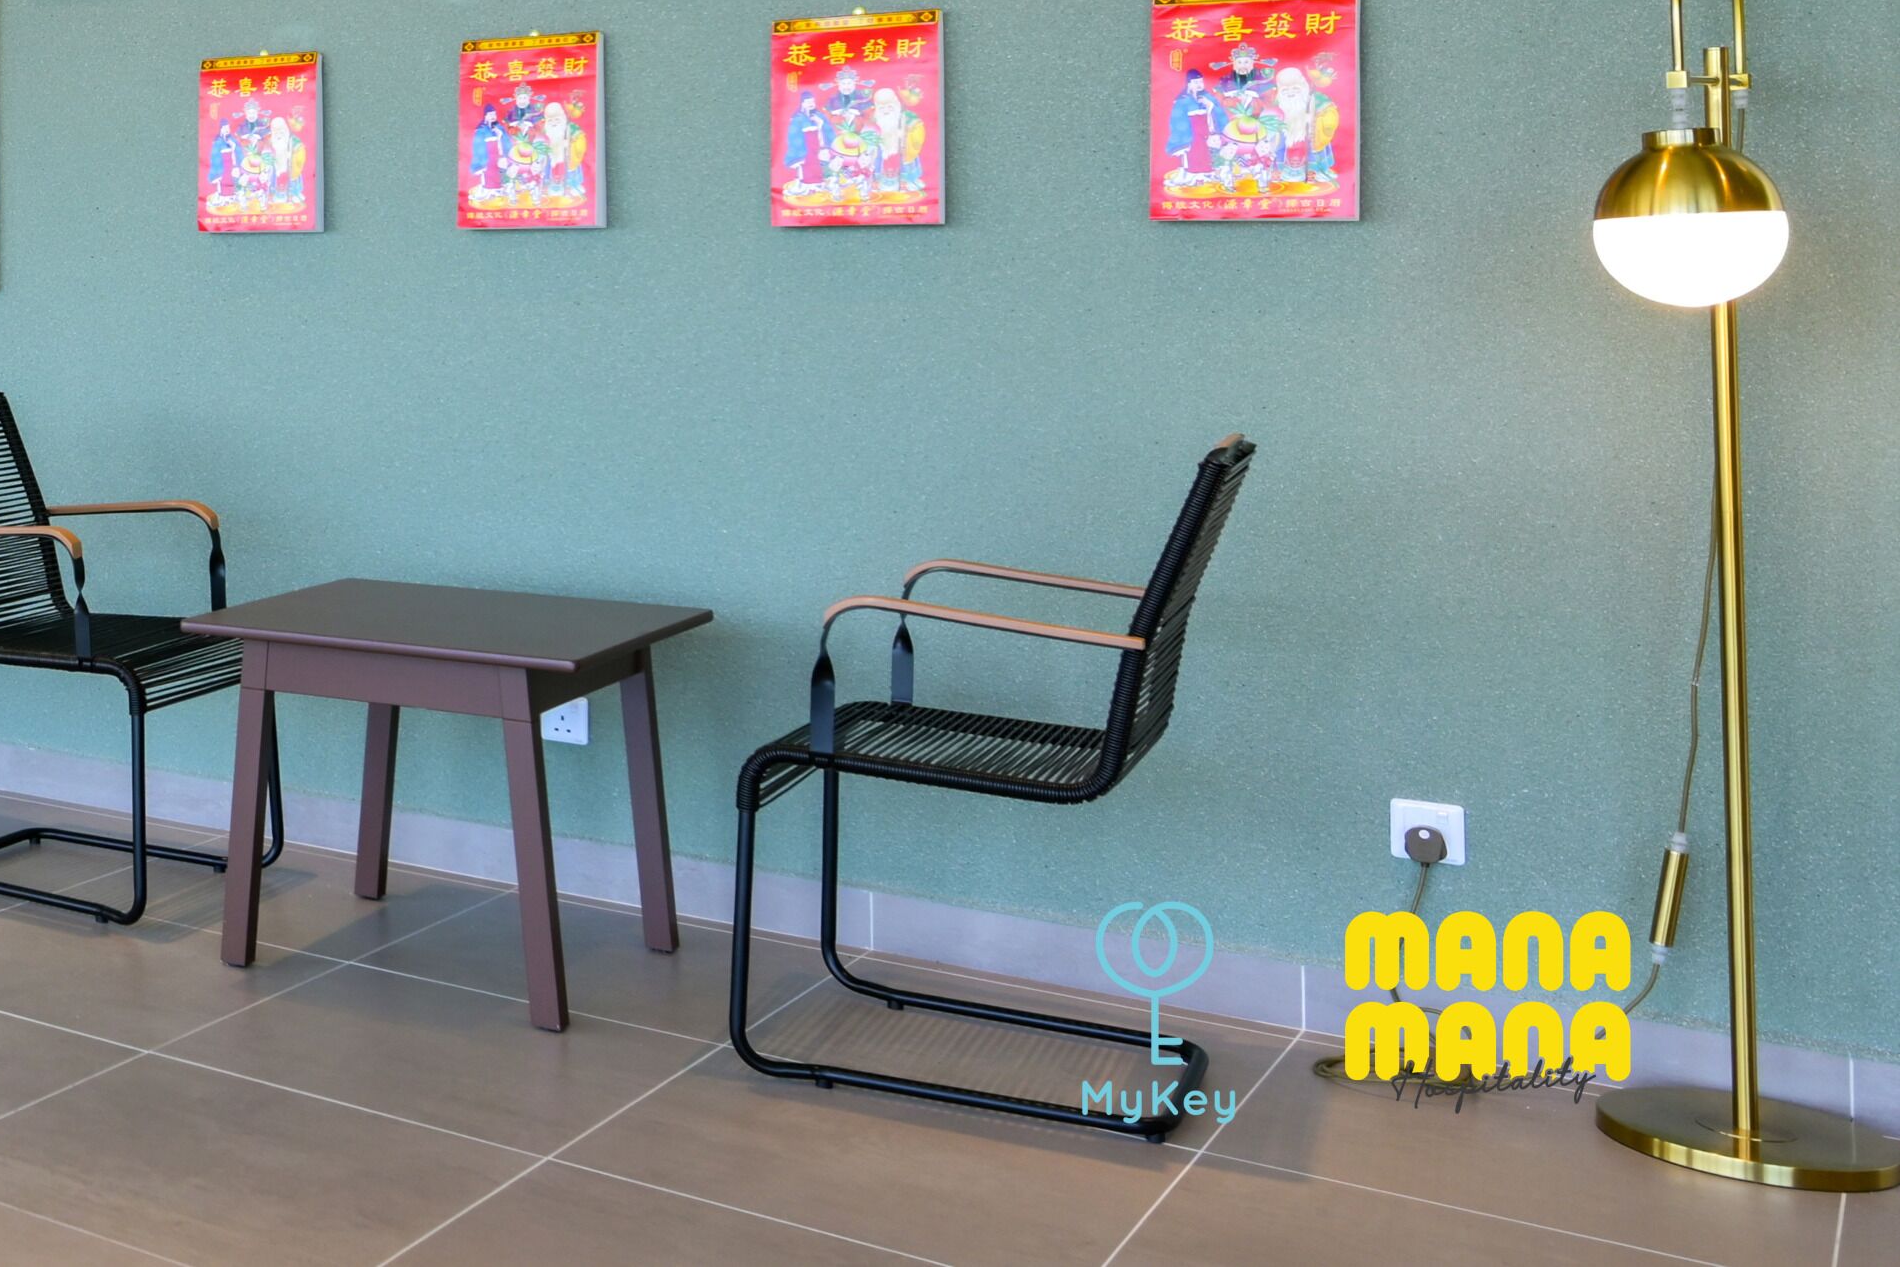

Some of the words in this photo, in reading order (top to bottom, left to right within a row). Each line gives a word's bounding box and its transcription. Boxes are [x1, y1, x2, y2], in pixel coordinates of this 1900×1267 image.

[1166, 11, 1343, 43] 恭喜發財
[783, 37, 927, 66] 恭喜發財
[470, 56, 589, 83] 恭喜發財
[207, 75, 308, 98] 恭喜發財
